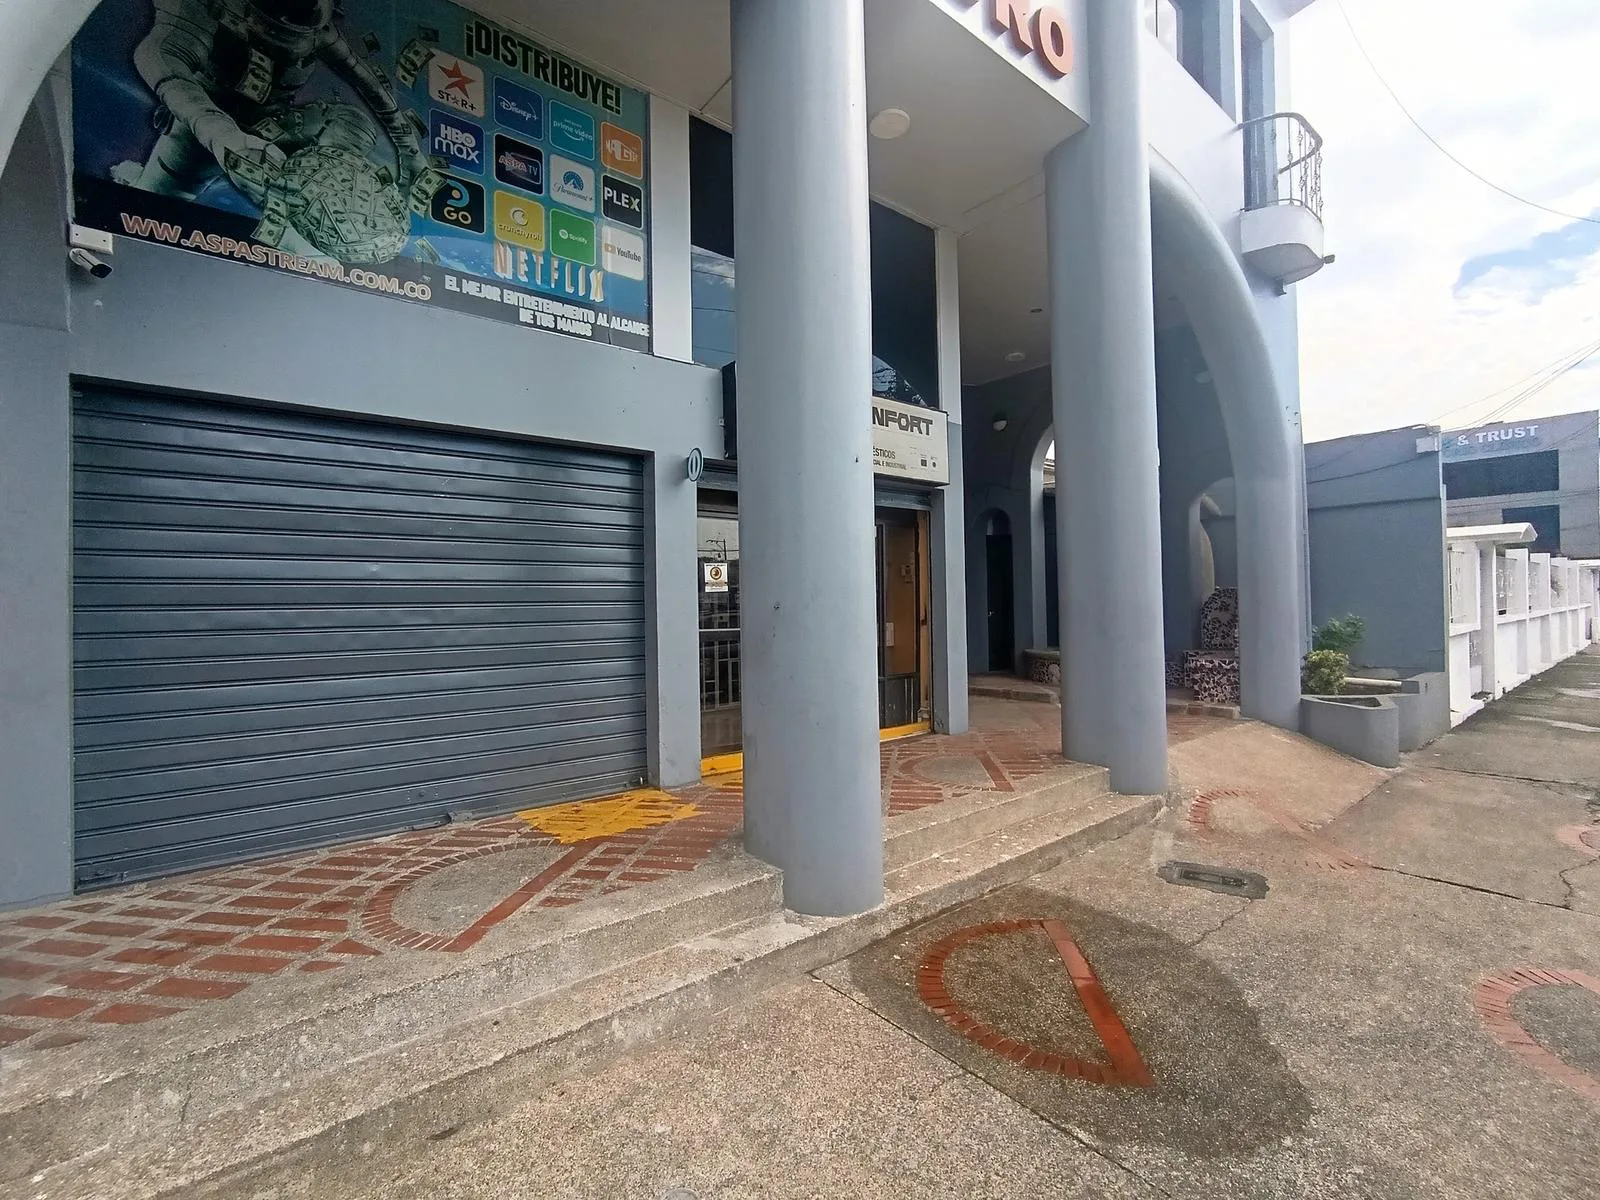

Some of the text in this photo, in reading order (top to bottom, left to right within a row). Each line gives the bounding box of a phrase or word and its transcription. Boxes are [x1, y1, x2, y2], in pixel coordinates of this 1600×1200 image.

[465, 20, 622, 116] ¡DISTRIBUYE!
[440, 123, 476, 148] HBO
[435, 137, 480, 164] max
[528, 164, 538, 176] TV
[604, 187, 640, 212] PLEX
[443, 206, 472, 225] GO
[569, 233, 588, 245] Spotify
[617, 247, 642, 263] YouTube
[494, 241, 604, 302] NETFLIX
[445, 274, 460, 292] EL
[462, 279, 501, 302] MEJOR
[596, 312, 610, 327] AL
[610, 317, 650, 337] ALCANCE
[519, 308, 593, 337] DE TUS MANOS
[1457, 425, 1539, 446] & TRUST
